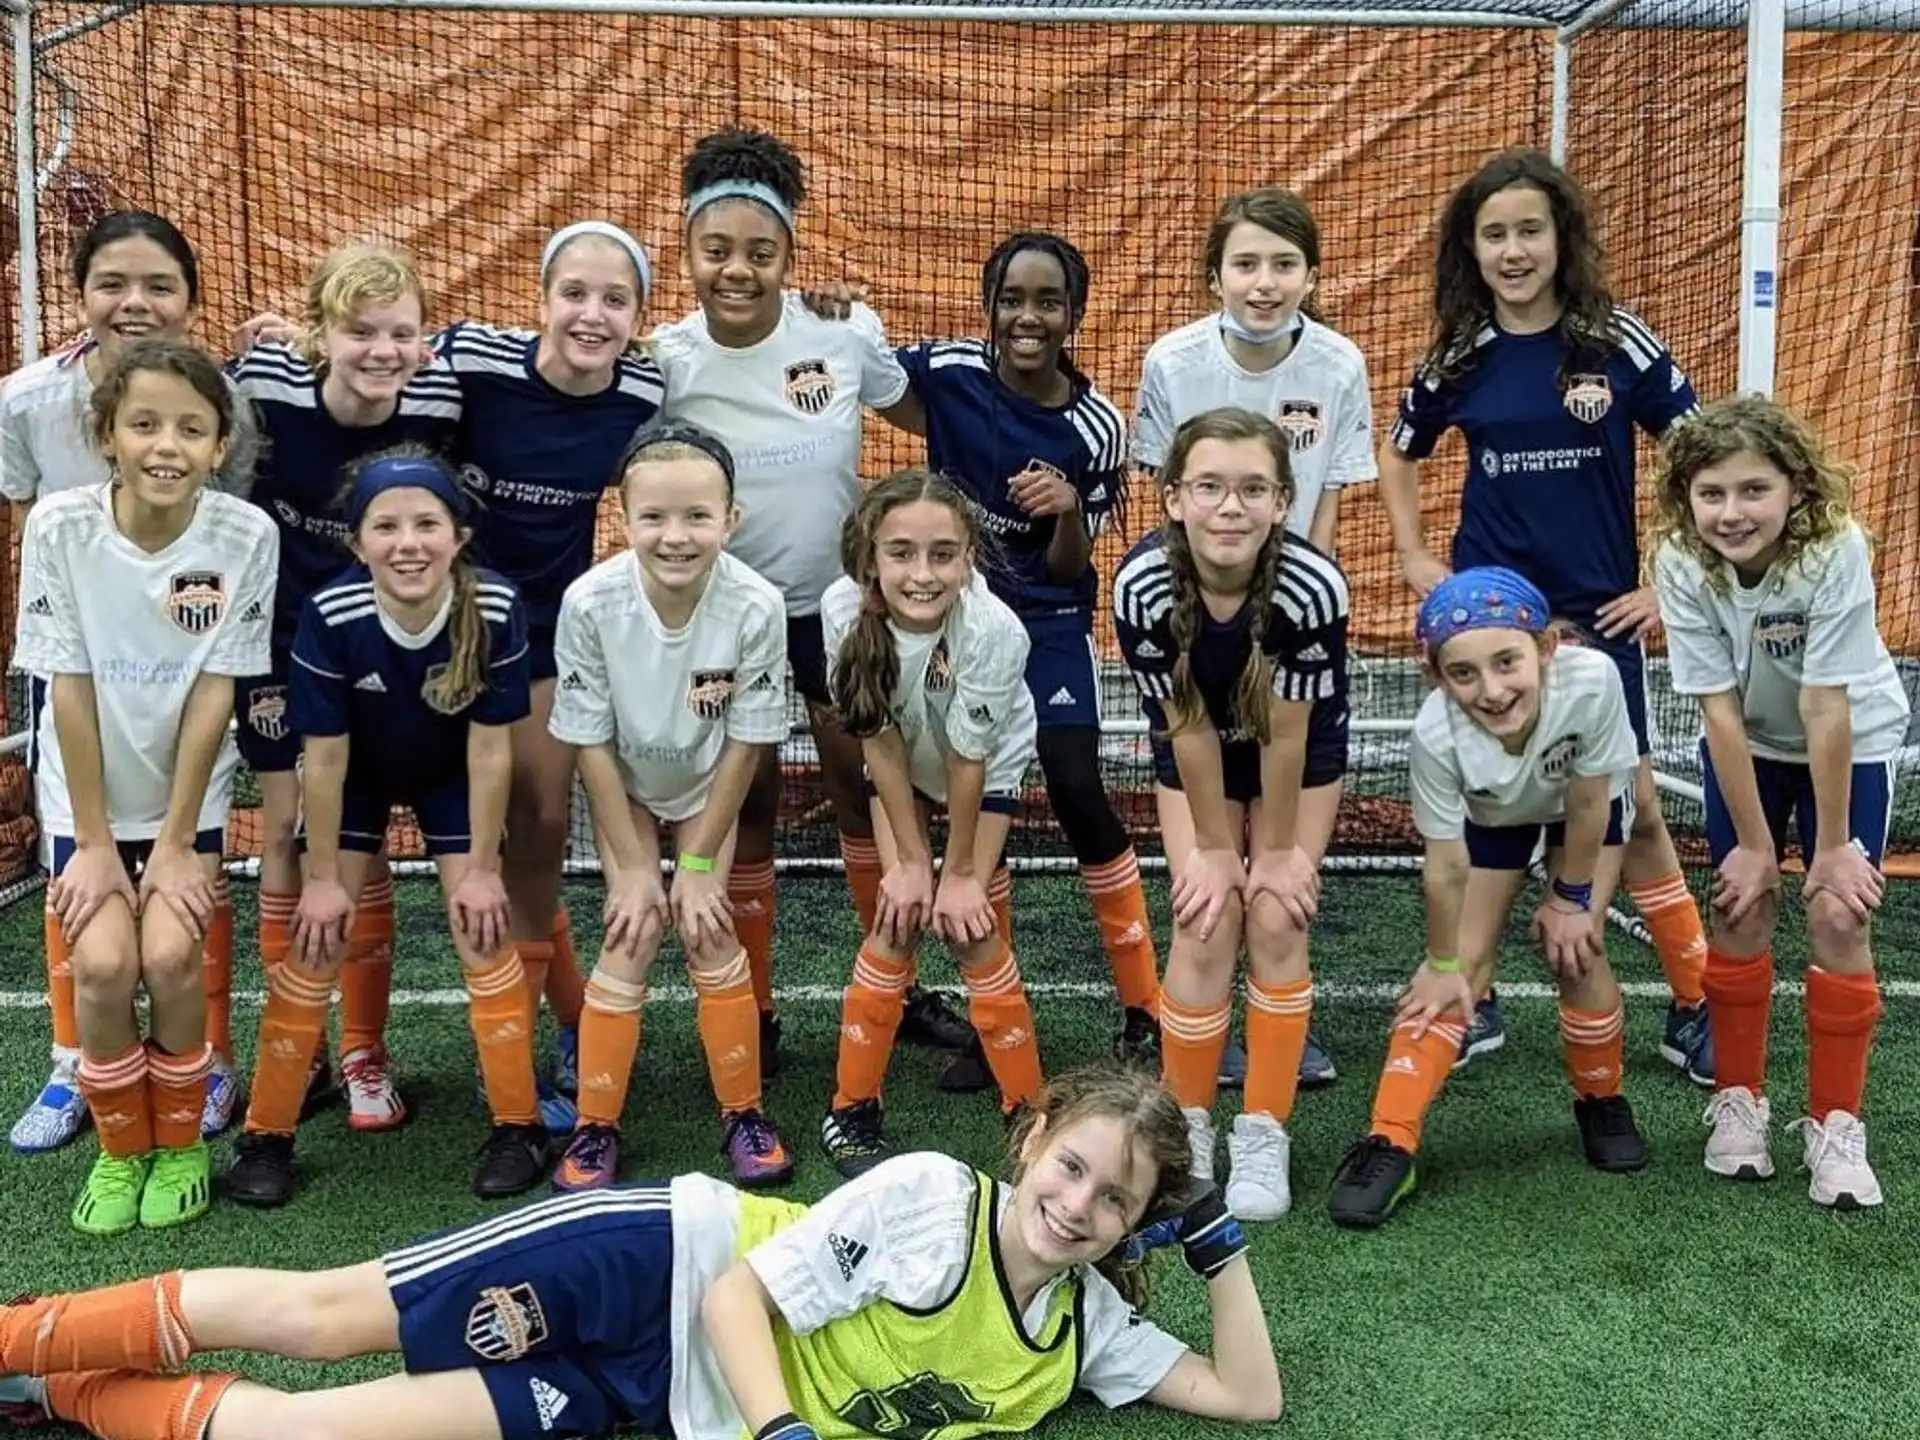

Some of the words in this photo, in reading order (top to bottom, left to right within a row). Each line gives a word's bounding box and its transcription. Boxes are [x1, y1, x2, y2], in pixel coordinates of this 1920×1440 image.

[1502, 446, 1601, 462] ORTHODONTICS
[1502, 463, 1518, 473] BY
[1522, 461, 1545, 472] THE
[1549, 459, 1579, 470] LAKE
[516, 491, 540, 504] THE
[828, 1232, 854, 1282] adidas
[529, 1376, 553, 1431] adidas
